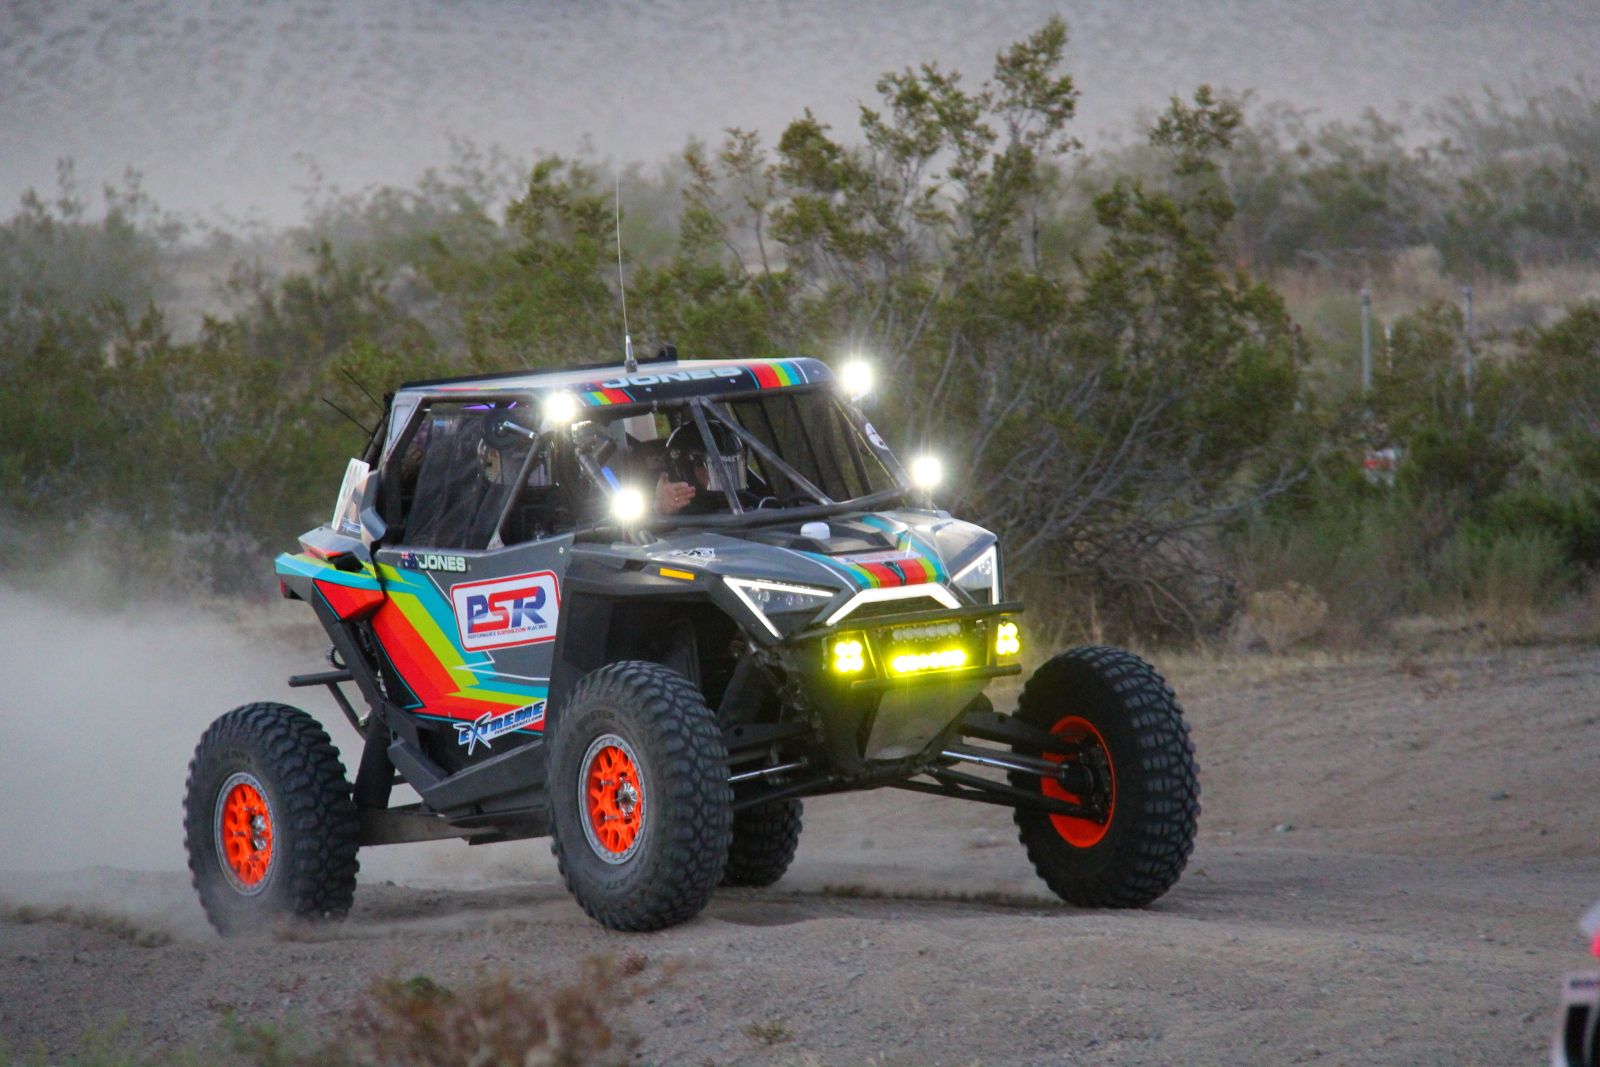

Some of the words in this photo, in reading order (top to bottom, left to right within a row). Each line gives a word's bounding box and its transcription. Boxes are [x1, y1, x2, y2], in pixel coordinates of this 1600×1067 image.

[601, 366, 743, 389] JONES
[418, 553, 466, 572] JONES
[466, 585, 547, 634] PSR
